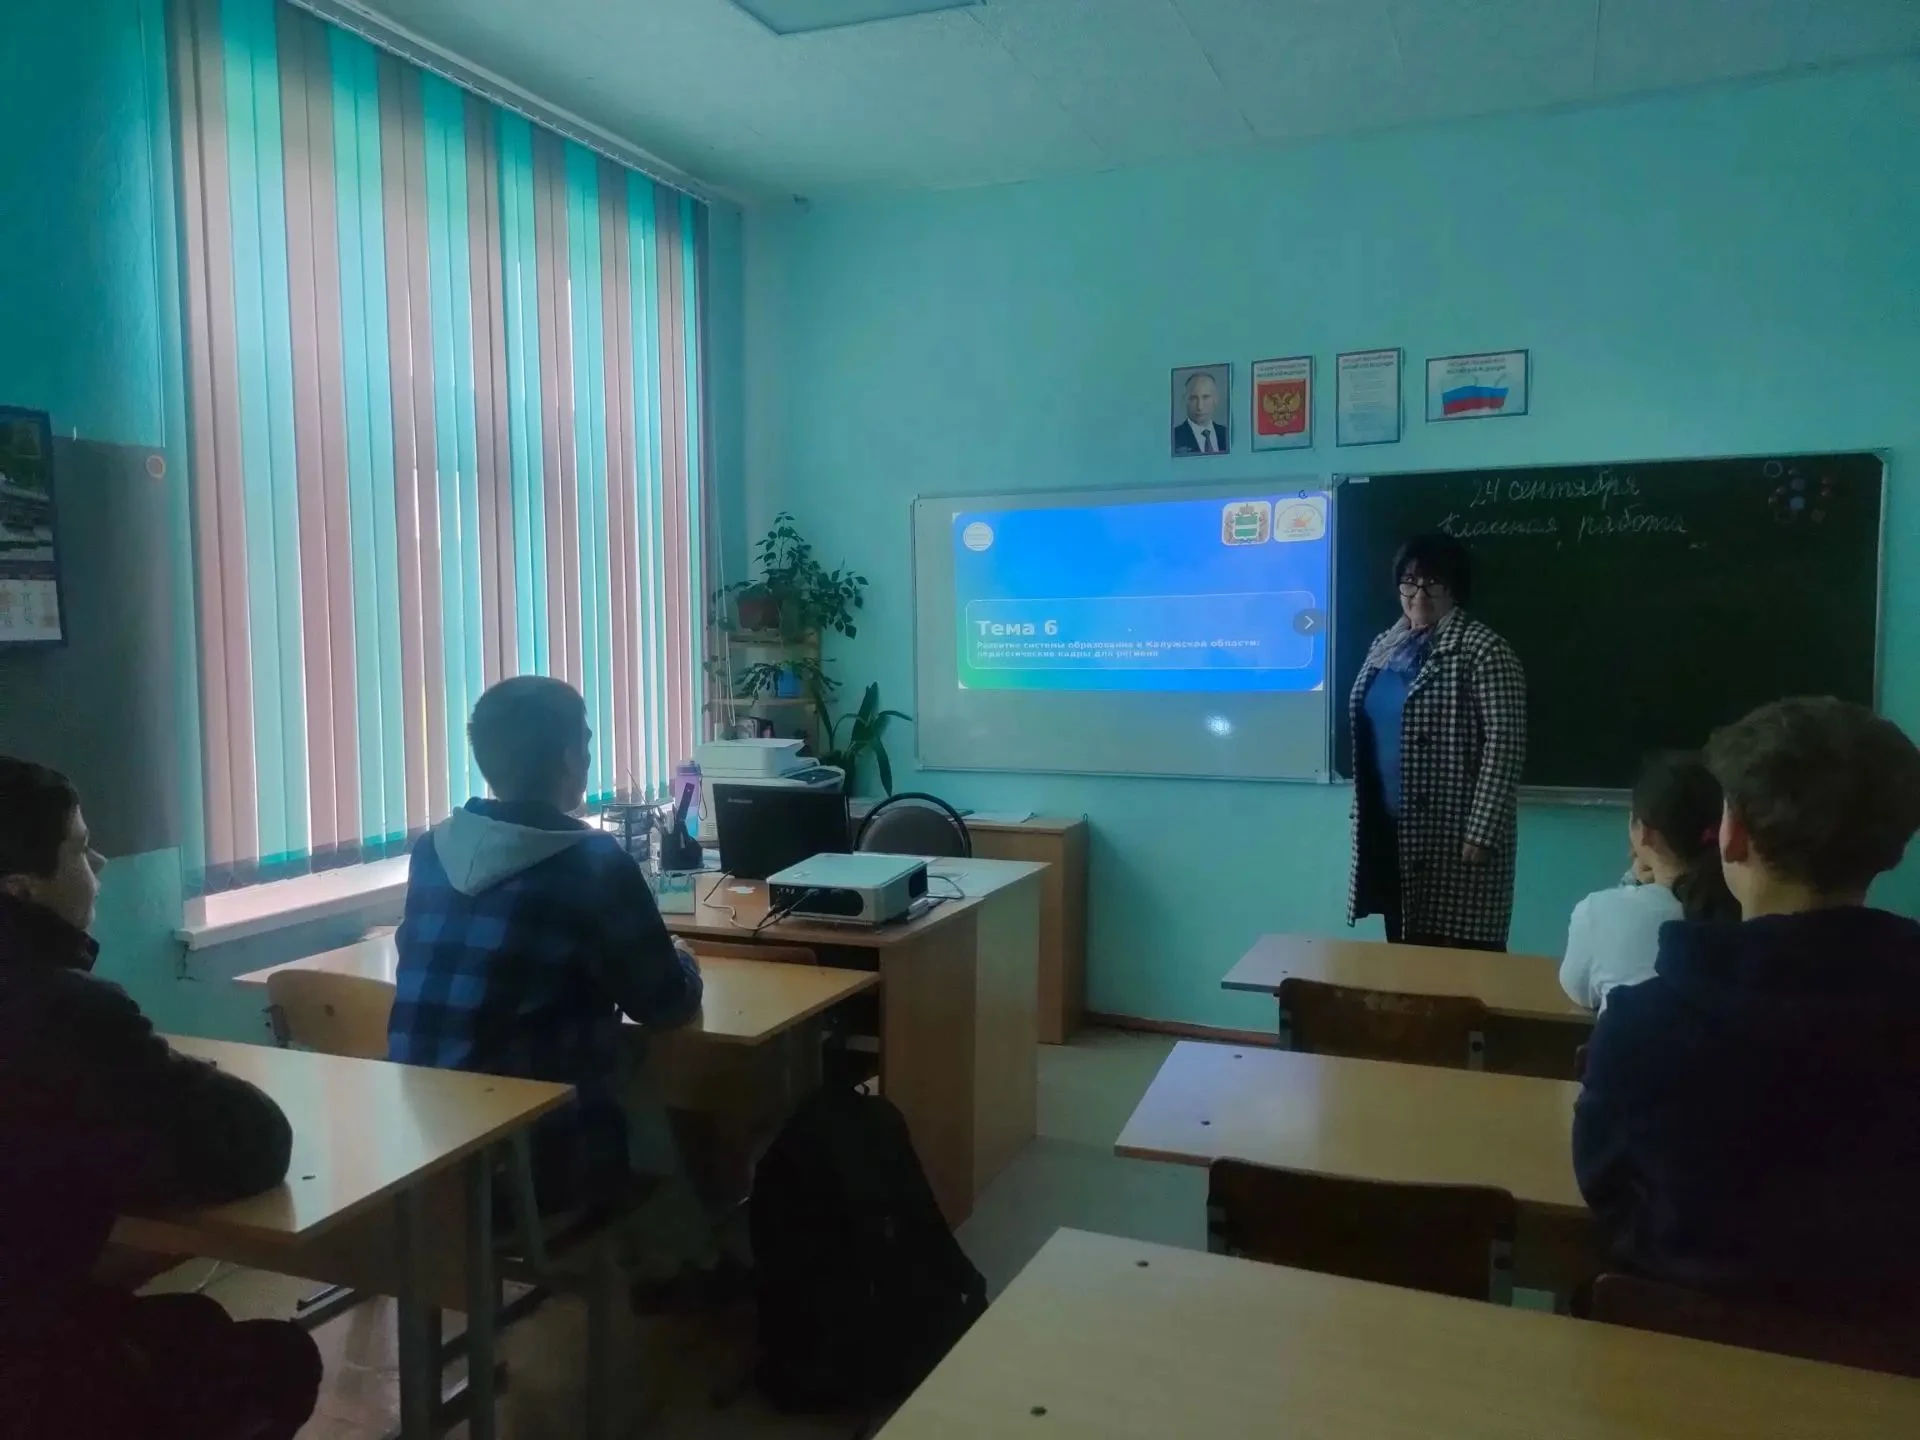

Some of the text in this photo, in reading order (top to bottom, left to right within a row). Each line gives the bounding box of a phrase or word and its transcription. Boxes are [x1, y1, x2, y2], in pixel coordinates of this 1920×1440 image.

[1470, 467, 1641, 510] 24 сентября
[1577, 503, 1689, 544] работа
[975, 619, 1059, 636] Тема 6
[1024, 641, 1066, 650] системы
[1146, 639, 1208, 650] Калужской
